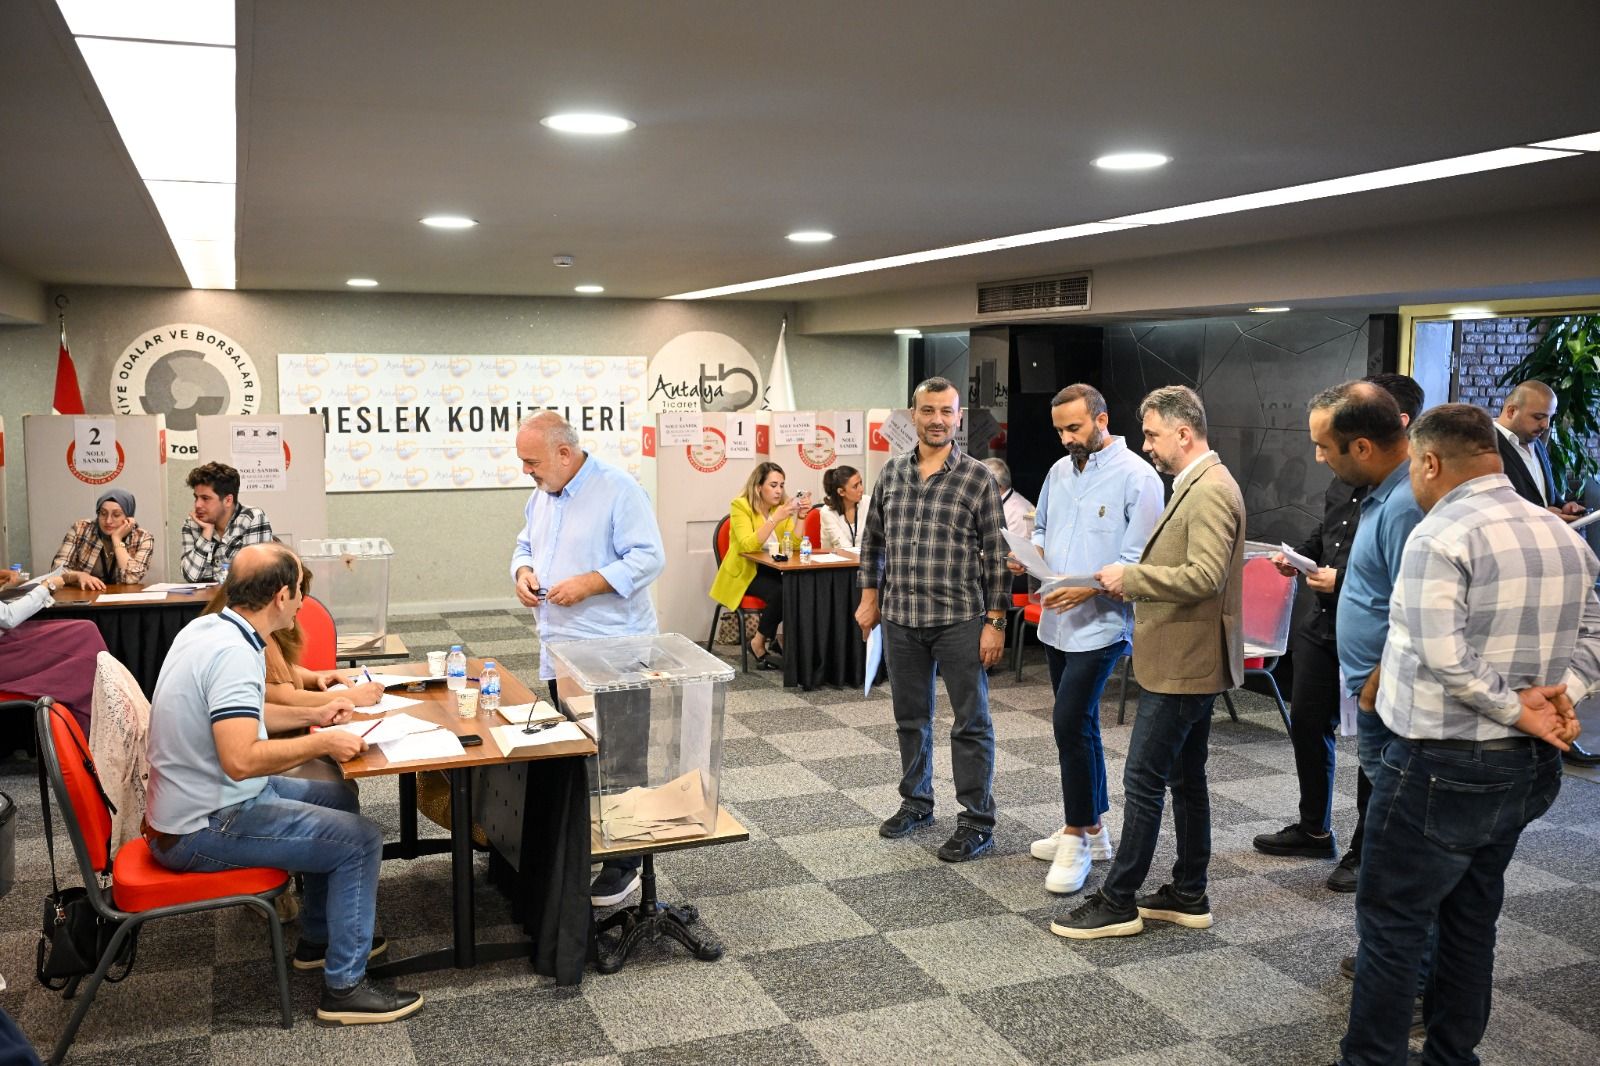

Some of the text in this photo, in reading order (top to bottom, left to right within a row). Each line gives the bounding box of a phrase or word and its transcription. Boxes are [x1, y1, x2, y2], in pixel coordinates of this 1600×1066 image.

[119, 334, 164, 380] ODALAR
[169, 329, 188, 339] VE
[196, 331, 254, 389] BORSALAR
[648, 374, 724, 404] Antalya
[662, 400, 697, 408] Ticaret
[447, 401, 625, 433] KOMİLERİ
[737, 421, 743, 436] 1
[846, 418, 852, 433] 1
[89, 427, 101, 445] 2
[171, 444, 198, 454] TOB
